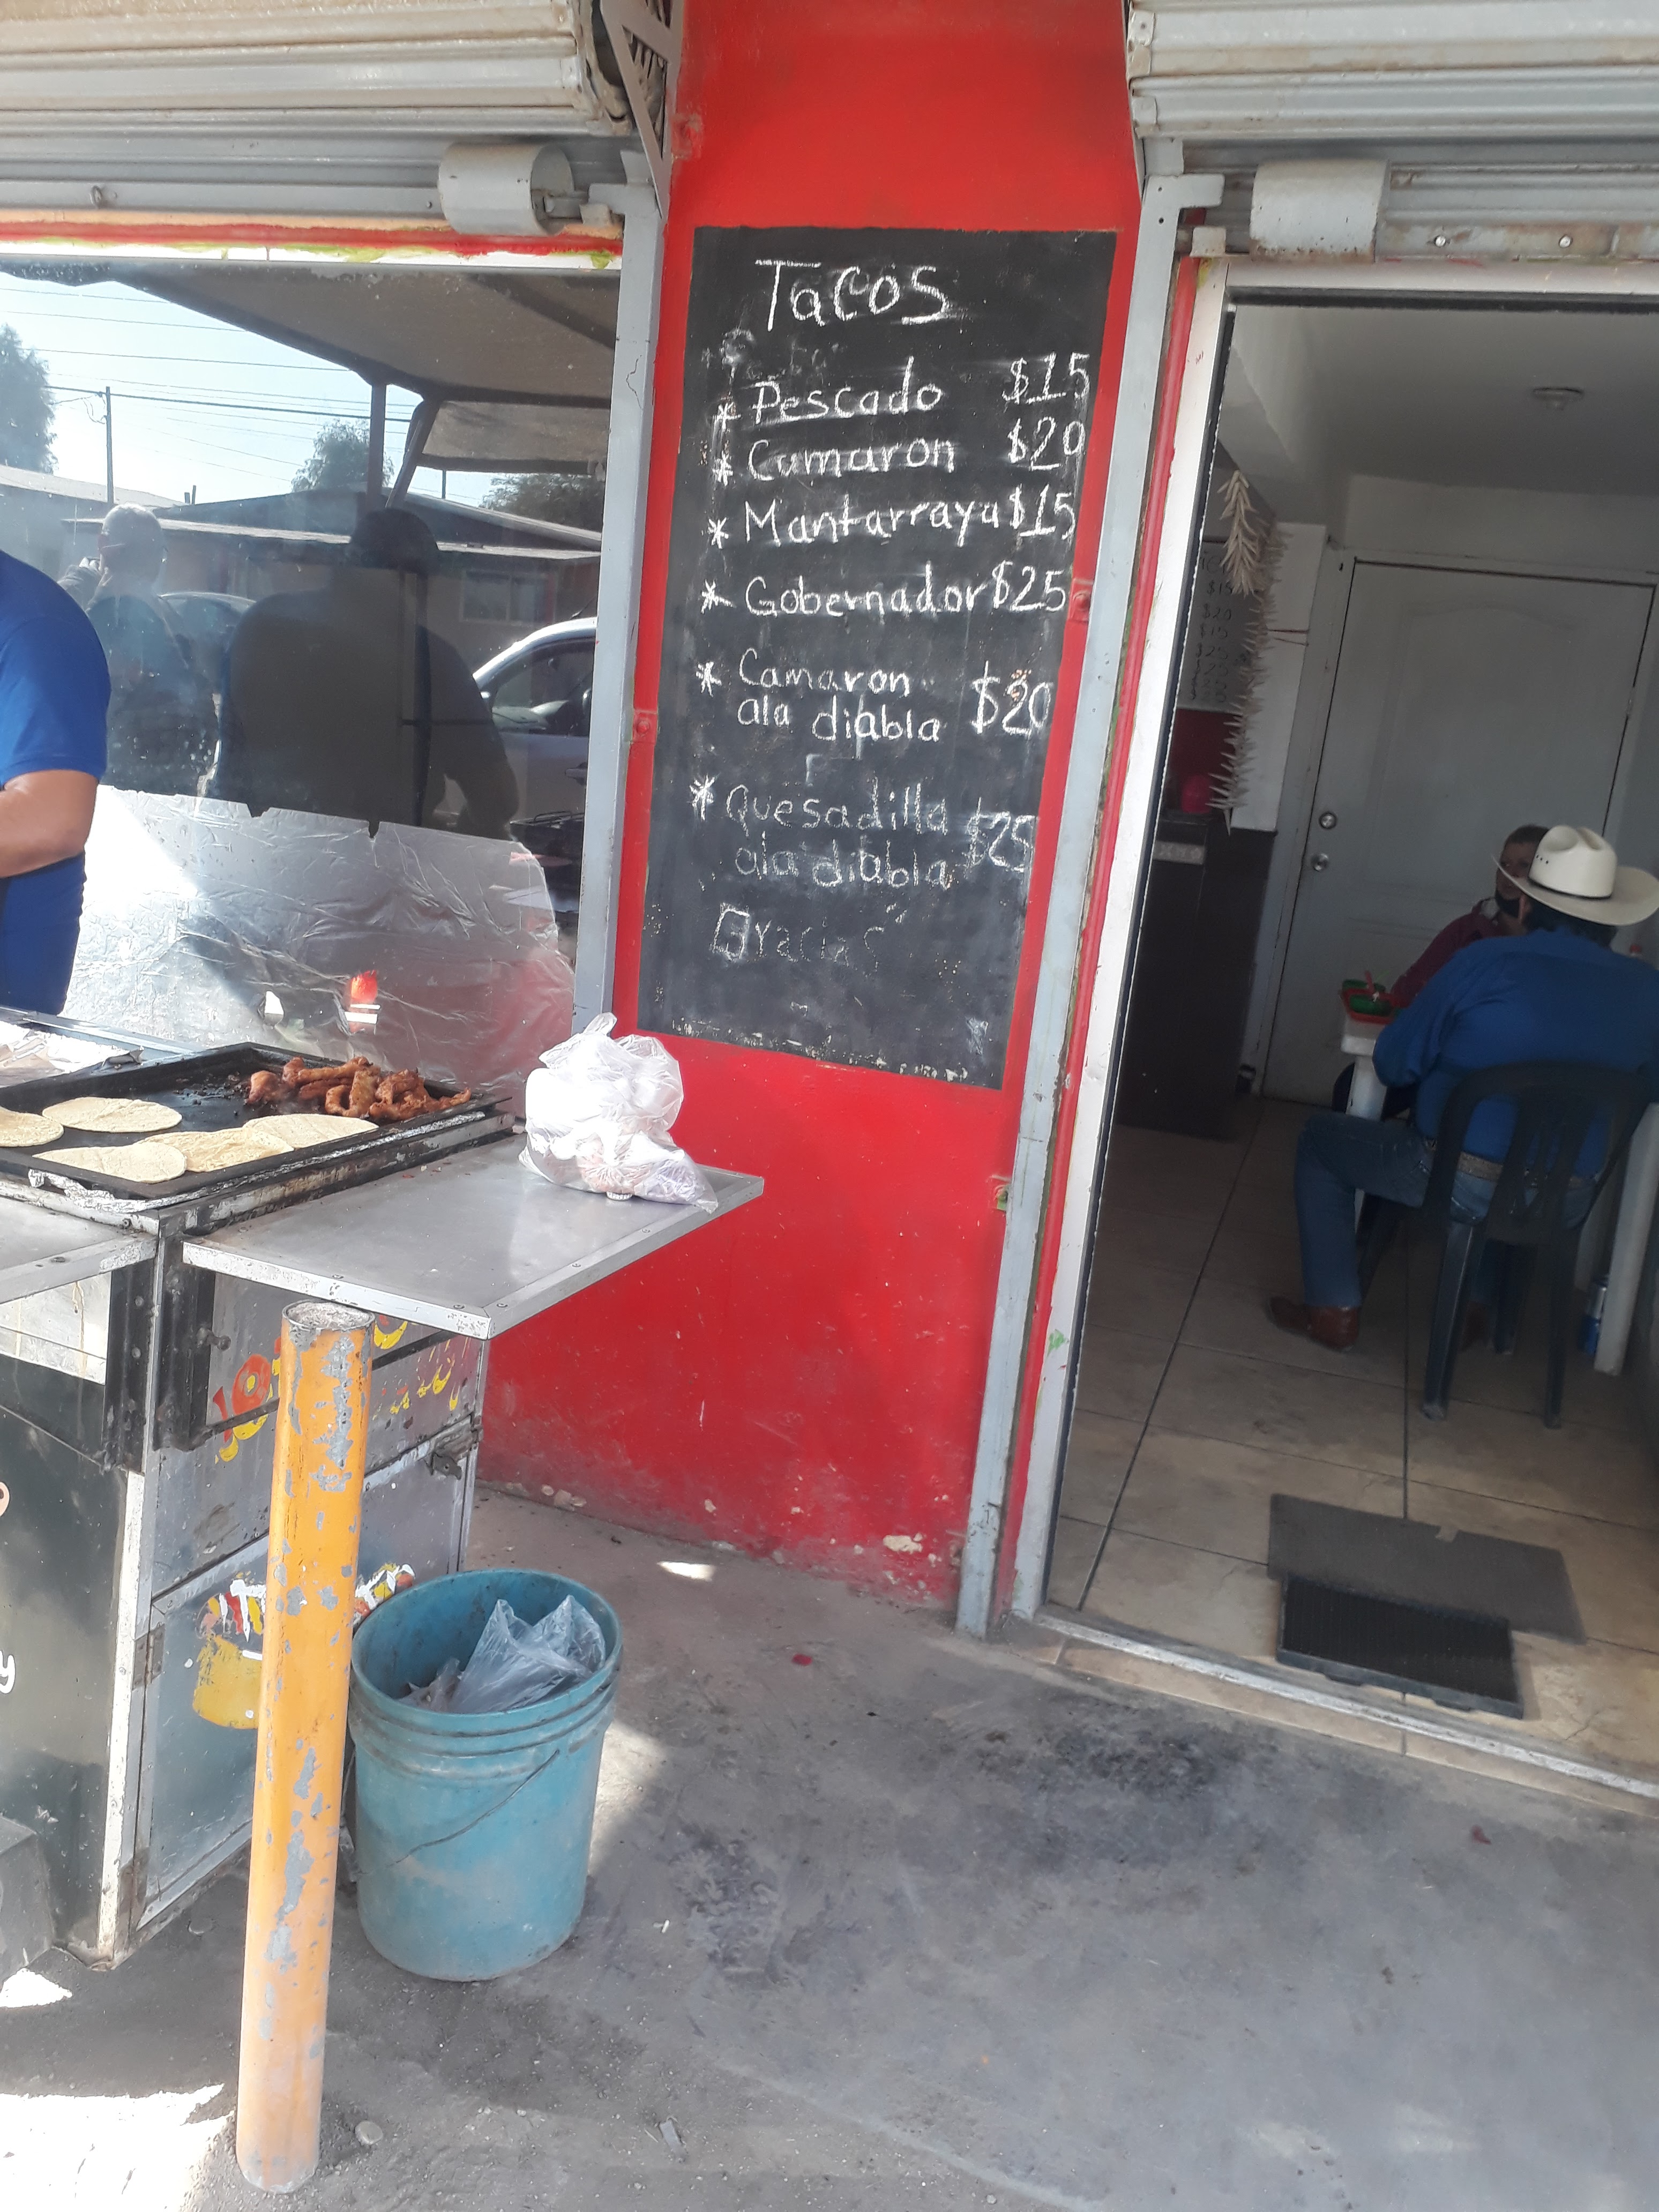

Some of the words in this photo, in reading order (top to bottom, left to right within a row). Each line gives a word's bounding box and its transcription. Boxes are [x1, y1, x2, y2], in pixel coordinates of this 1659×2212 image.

[751, 356, 944, 424] Pescado
[1002, 352, 1090, 404] $15
[1007, 416, 1087, 472] $20
[1008, 483, 1076, 539] $15
[745, 561, 987, 625] Gobernador
[990, 559, 1067, 612] $25
[738, 647, 911, 697] Camaron
[970, 660, 1053, 735] $20
[811, 694, 941, 743] diabla
[726, 776, 948, 837] Quesadilla
[812, 839, 951, 891] diabla
